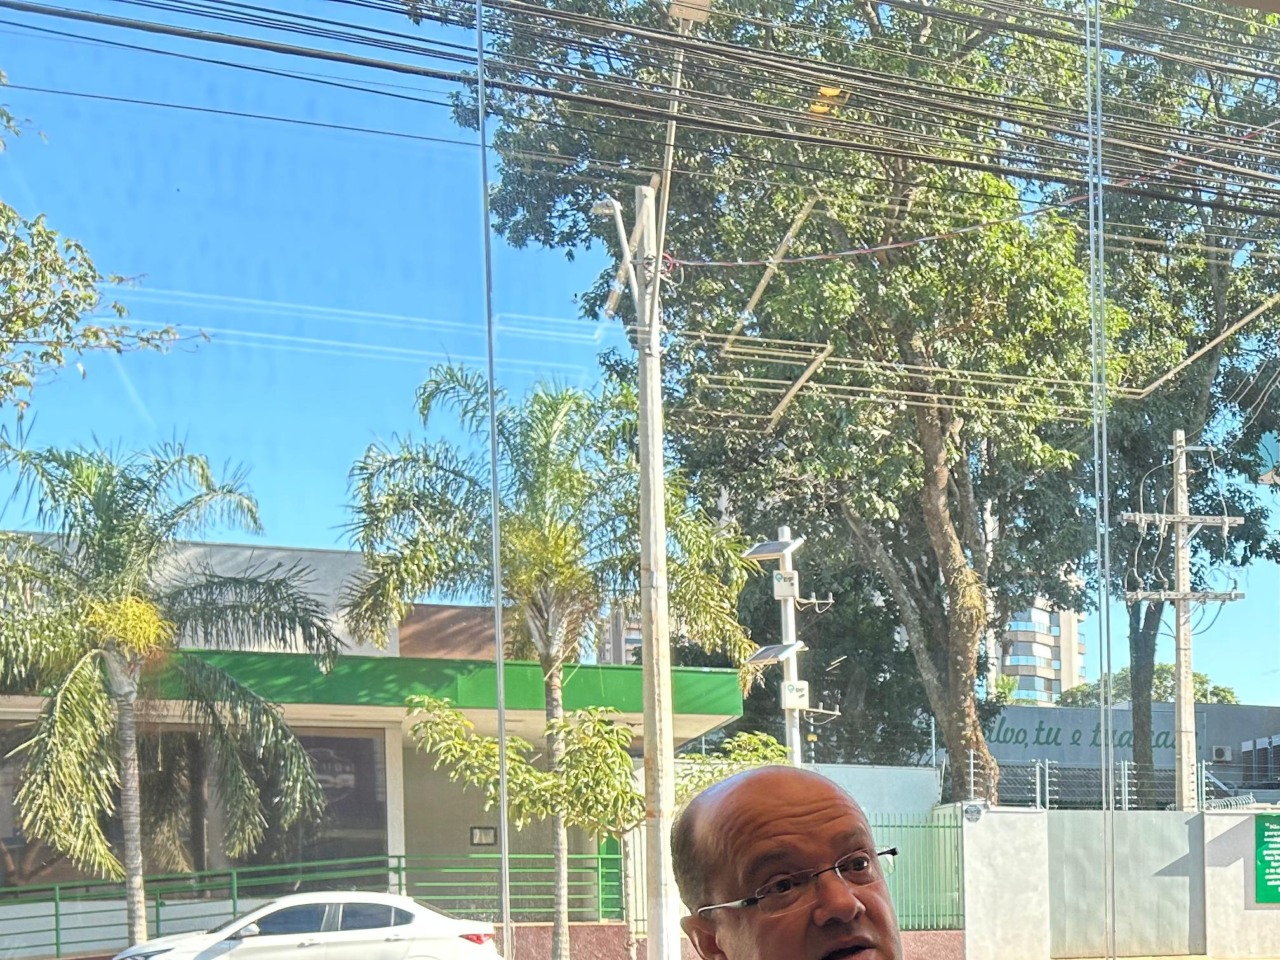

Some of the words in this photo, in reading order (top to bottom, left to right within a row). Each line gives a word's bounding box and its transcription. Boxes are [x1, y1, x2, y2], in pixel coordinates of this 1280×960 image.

[983, 716, 1028, 749] alvo,
[1033, 720, 1062, 746] tu
[1069, 729, 1083, 746] e
